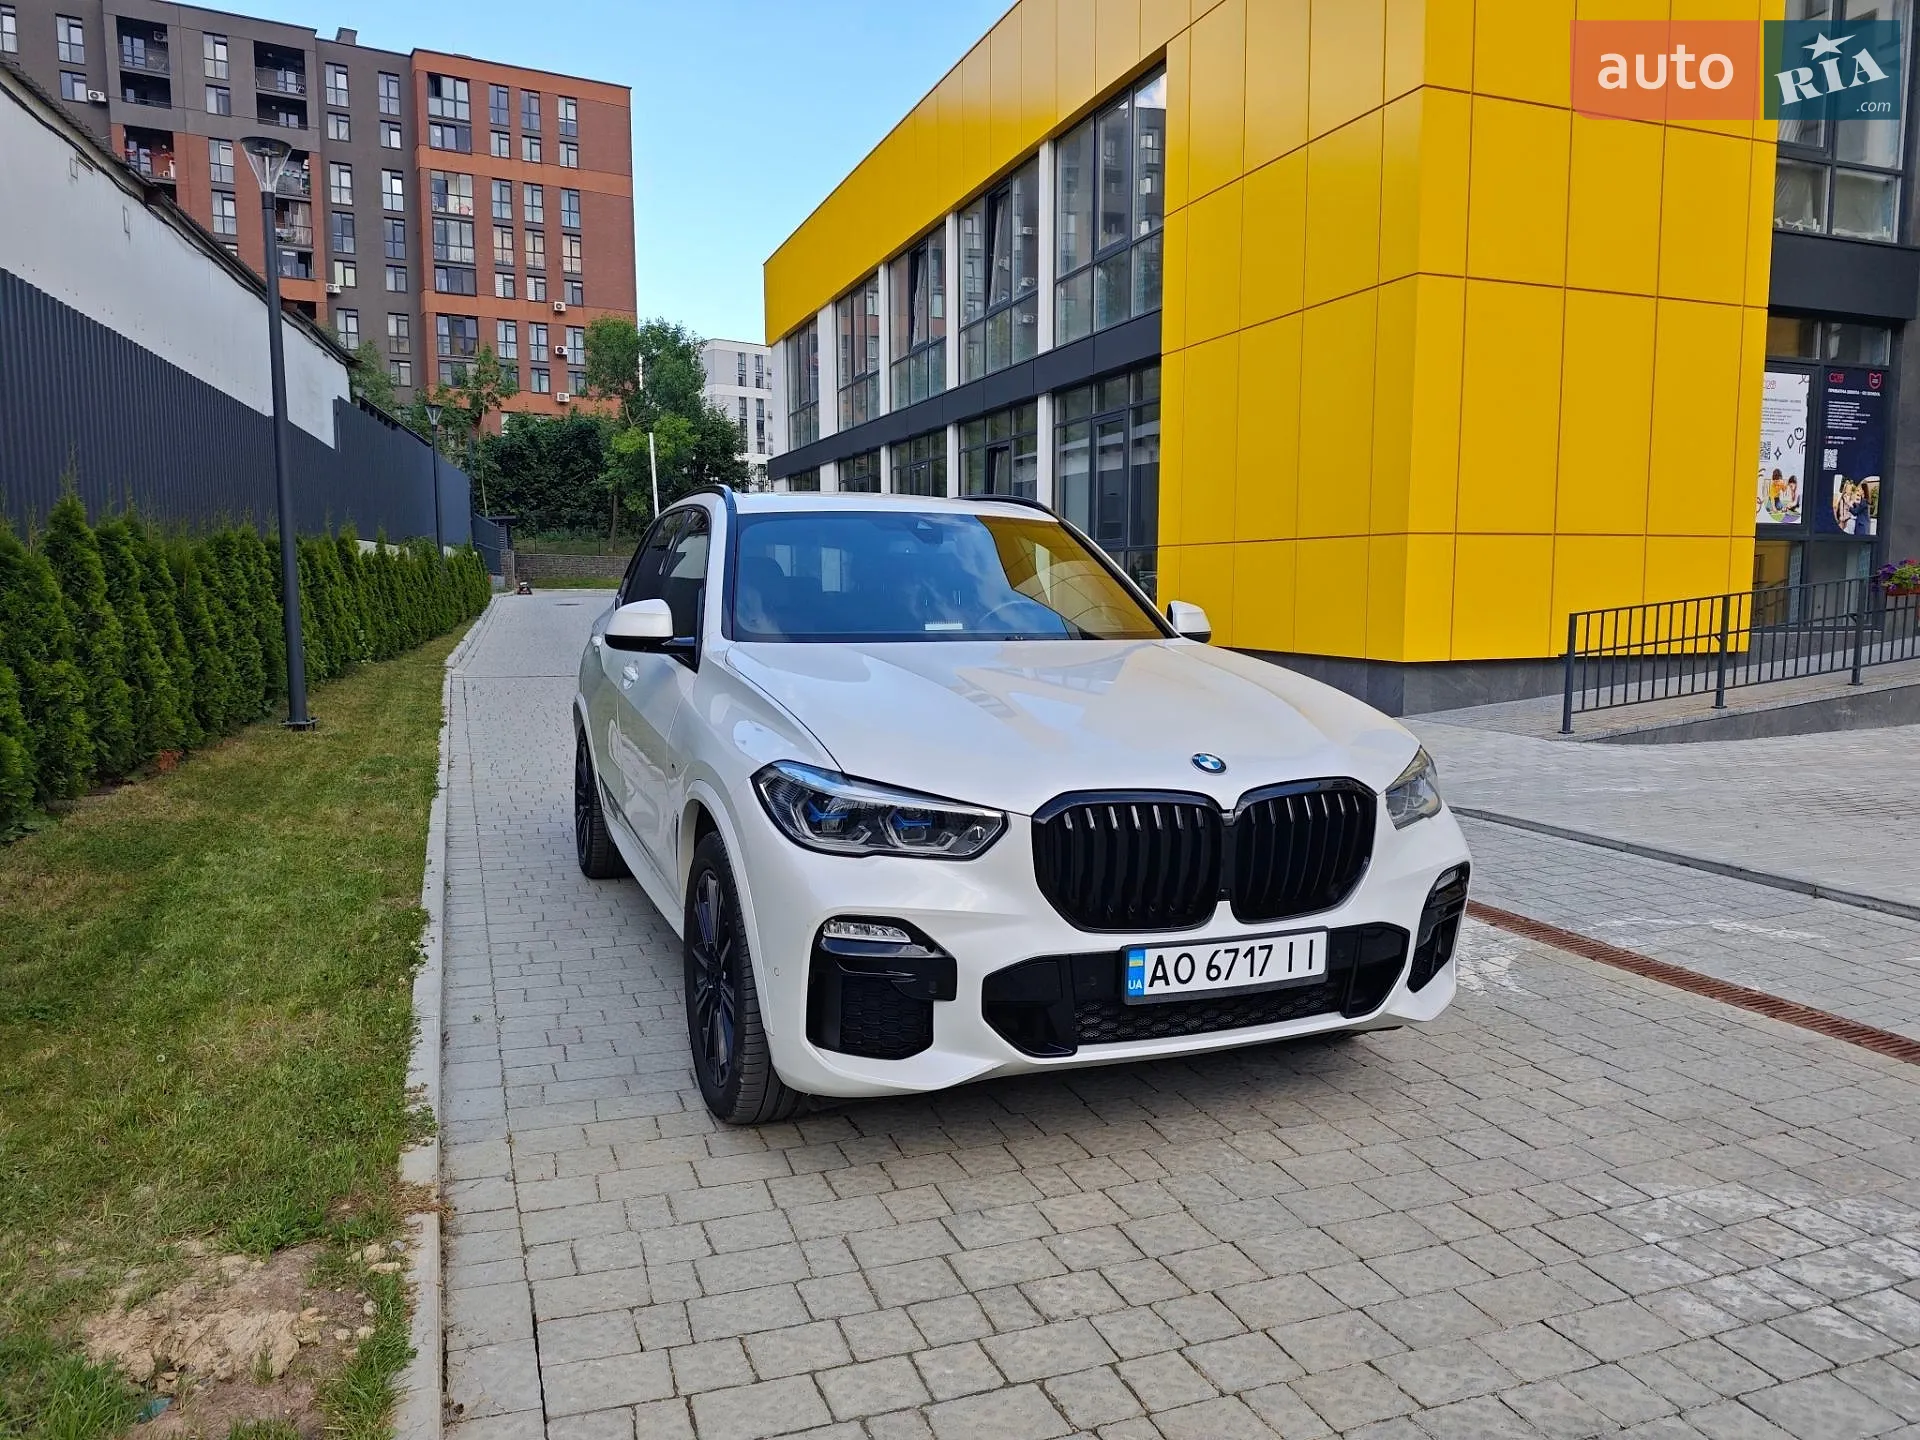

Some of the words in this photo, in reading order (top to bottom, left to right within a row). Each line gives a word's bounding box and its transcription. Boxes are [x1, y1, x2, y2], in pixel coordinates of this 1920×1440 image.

[1148, 952, 1196, 988] AO
[1206, 944, 1274, 982] 6717
[1128, 979, 1143, 990] UA
